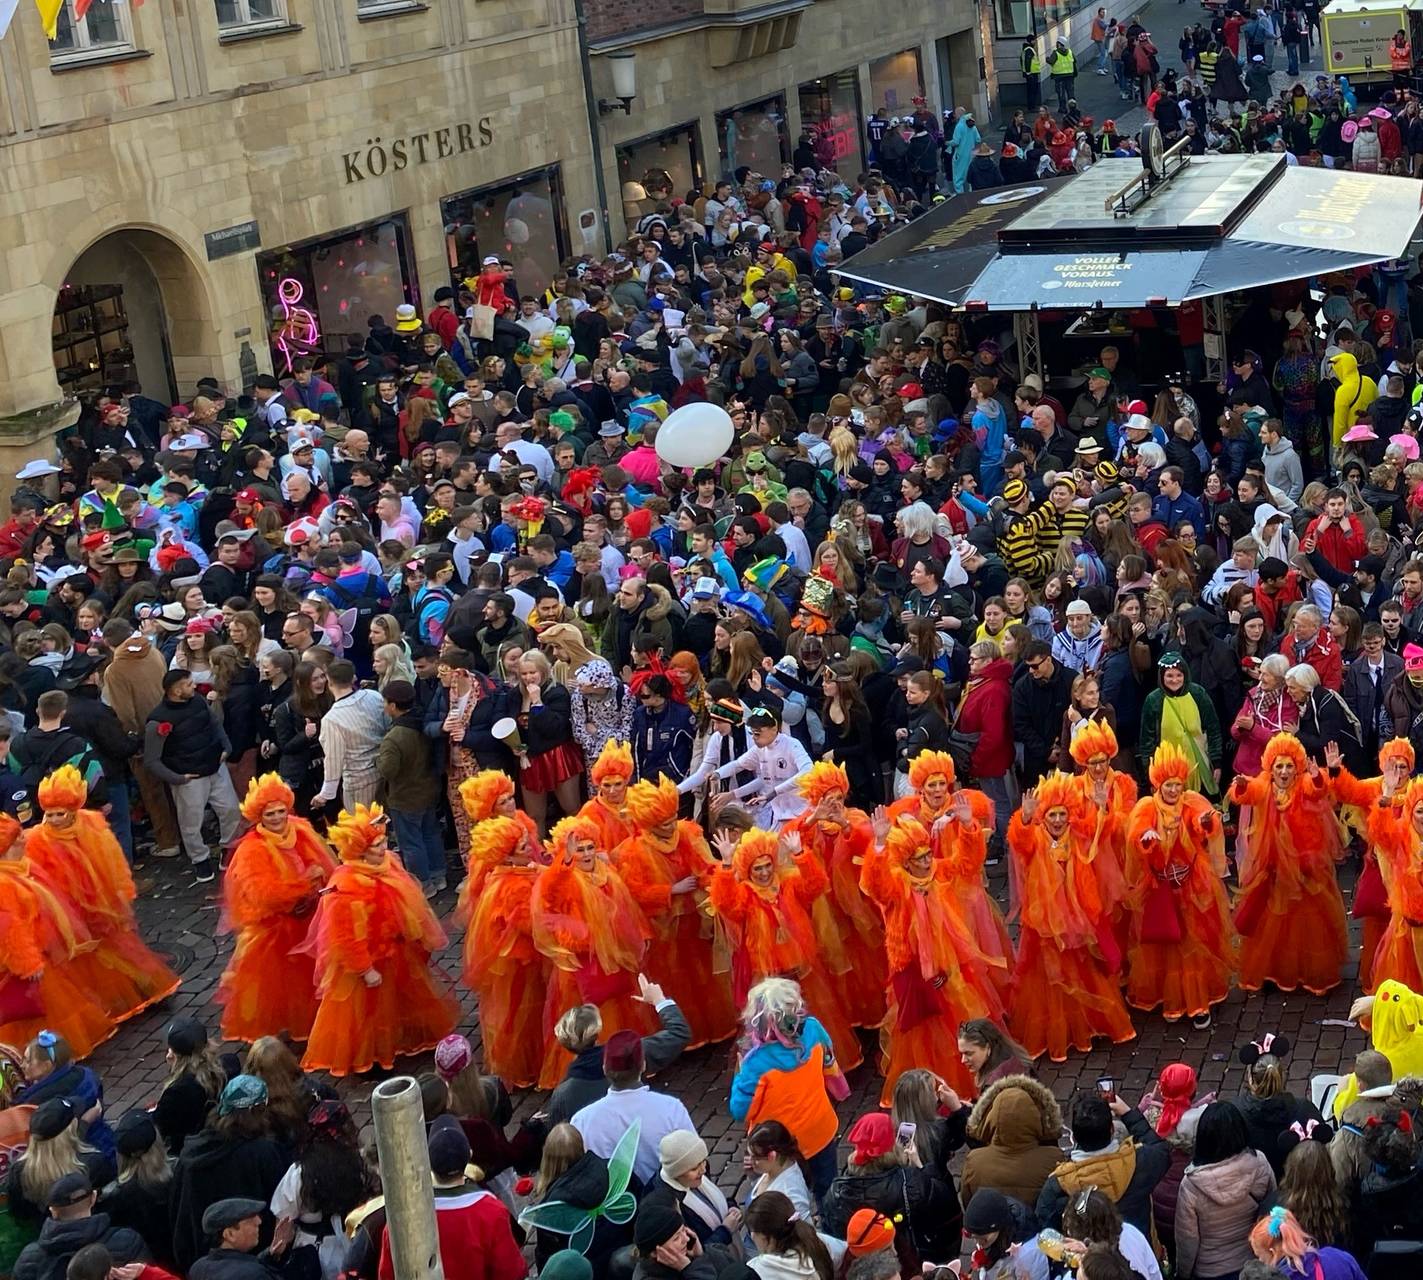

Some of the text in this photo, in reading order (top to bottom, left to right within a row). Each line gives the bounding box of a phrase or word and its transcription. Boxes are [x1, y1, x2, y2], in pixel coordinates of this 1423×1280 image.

[342, 116, 493, 184] KÖSTERS
[1074, 256, 1121, 264] VOLLER
[1053, 263, 1133, 272] GESCHMACK
[1063, 279, 1123, 289] Warsteiner
